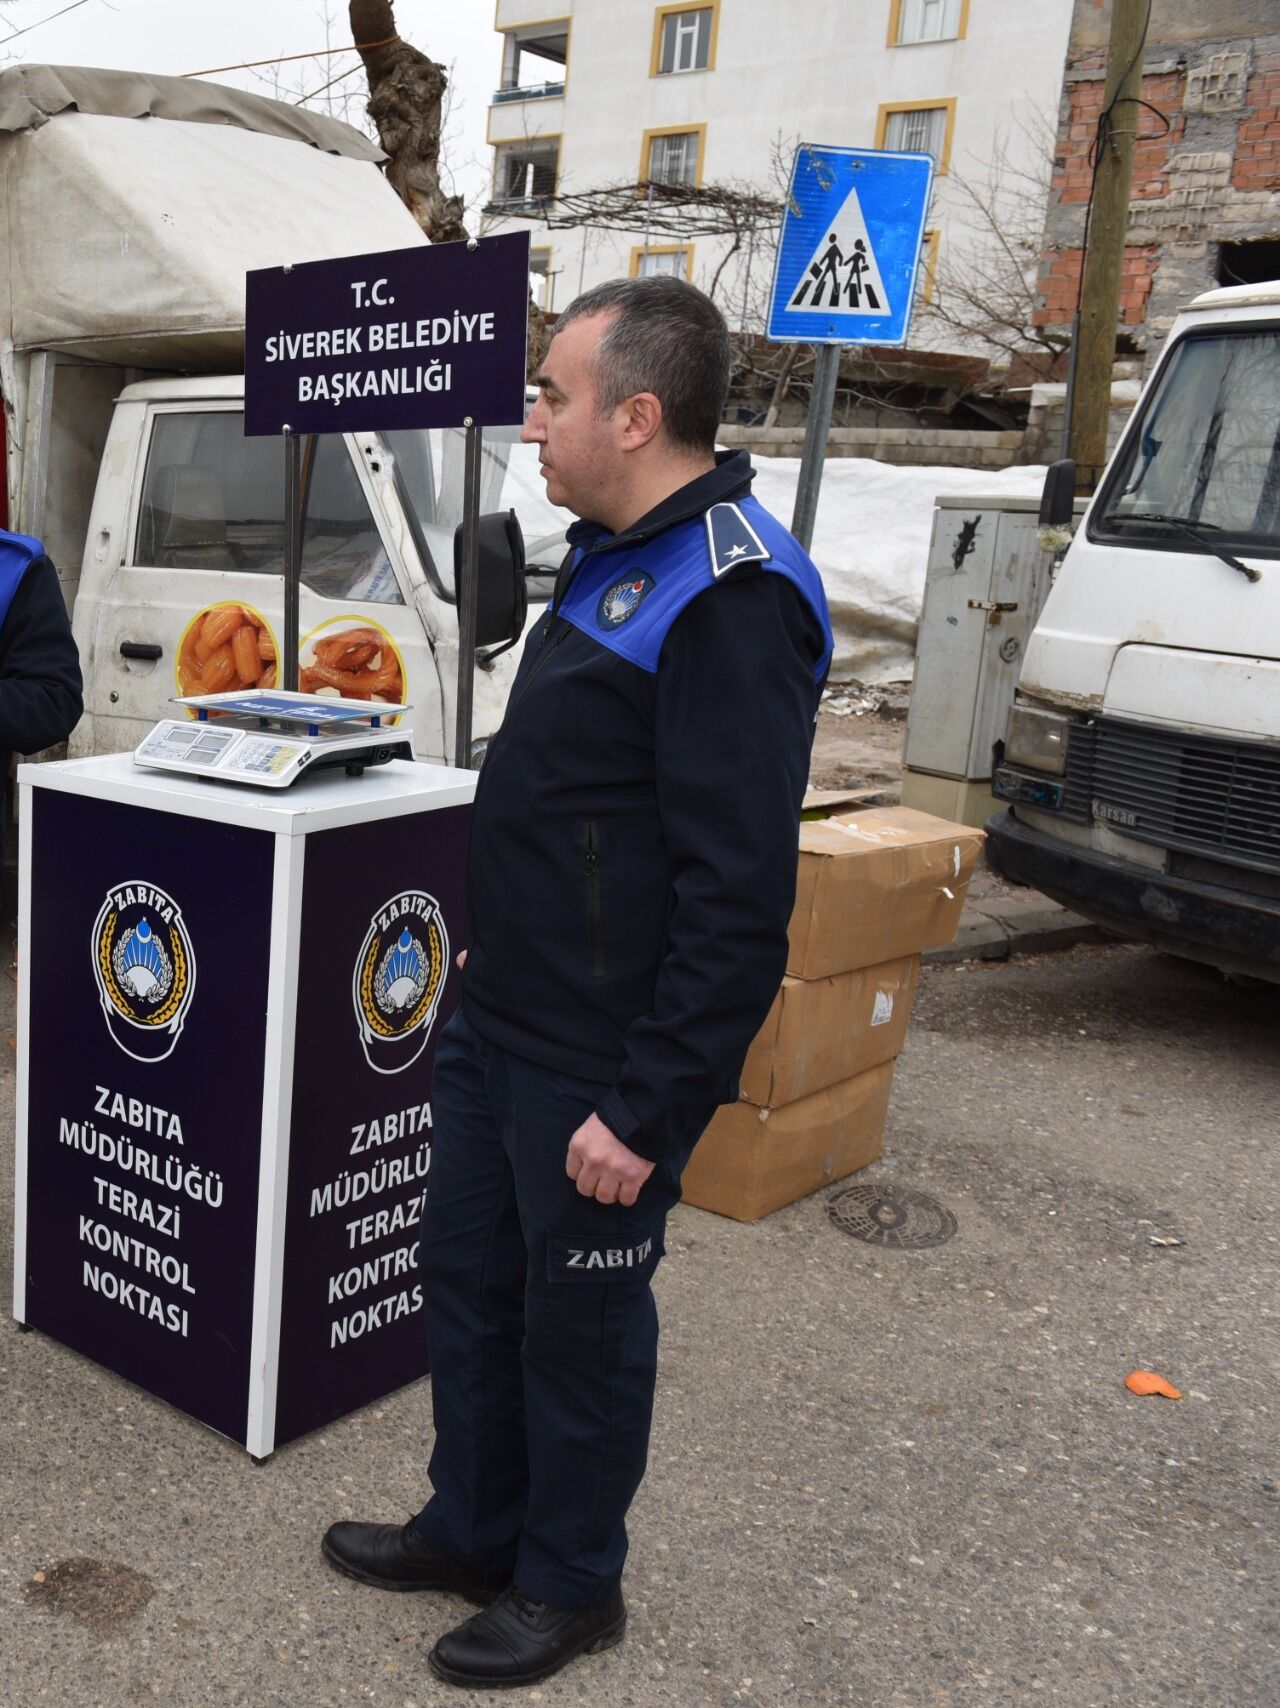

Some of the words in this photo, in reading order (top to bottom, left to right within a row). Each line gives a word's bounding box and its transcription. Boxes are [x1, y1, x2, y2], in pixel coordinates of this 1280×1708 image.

[351, 279, 395, 308] T.C.
[265, 330, 362, 362] SİVEREK
[369, 310, 495, 352] BELEDİYE
[298, 359, 452, 406] BAŞKANLIĞI
[1092, 799, 1136, 826] Karsan
[114, 886, 175, 924] ZABITA
[379, 896, 433, 932] ZABITA
[94, 1084, 184, 1145] ZABITA
[349, 1102, 433, 1155] ZABITA
[59, 1117, 223, 1208] MÜDÜRLÜĞÜ
[309, 1142, 431, 1218] MÜDÜRLÜ
[93, 1176, 180, 1240] TERAZİ
[79, 1214, 196, 1295] KONTROL
[328, 1241, 420, 1304] KONTR
[566, 1237, 652, 1269] ZABITA
[83, 1260, 189, 1337] NOKTASI
[331, 1284, 424, 1349] NOKTAS
